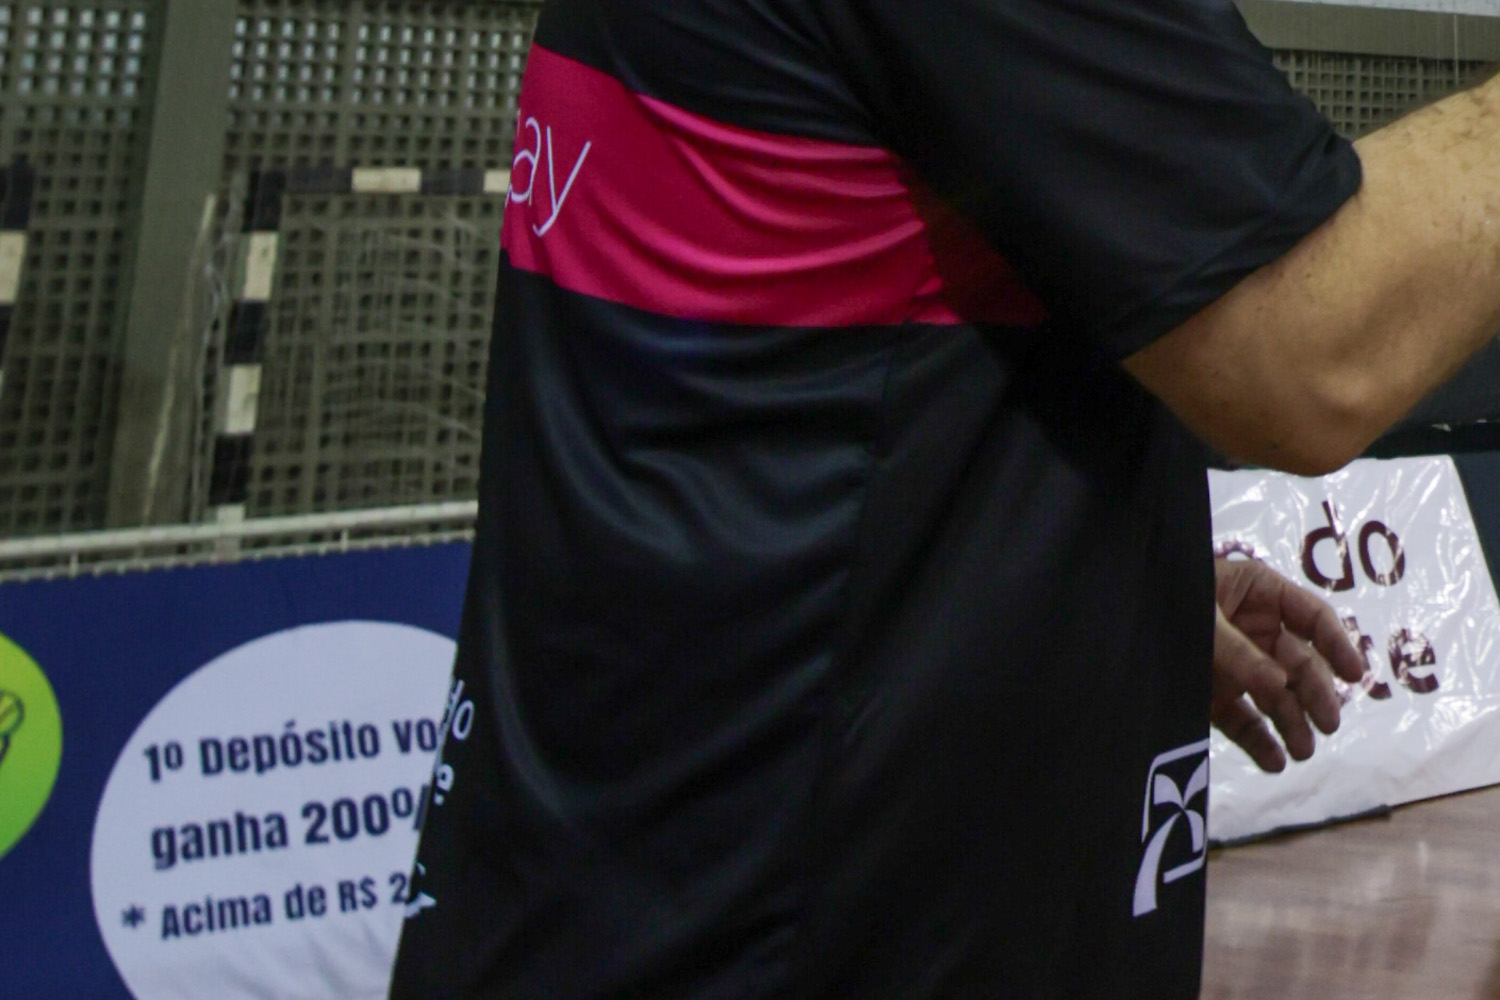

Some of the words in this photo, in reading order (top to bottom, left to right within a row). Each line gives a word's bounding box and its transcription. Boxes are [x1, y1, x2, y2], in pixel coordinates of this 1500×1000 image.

[505, 114, 592, 238] ay
[1302, 500, 1406, 592] do
[199, 718, 381, 777] Depósito
[391, 717, 439, 754] vo
[152, 810, 289, 872] ganha
[161, 892, 273, 941] Acima
[284, 881, 327, 922] de
[337, 874, 379, 914] R$
[388, 871, 408, 905] 2
